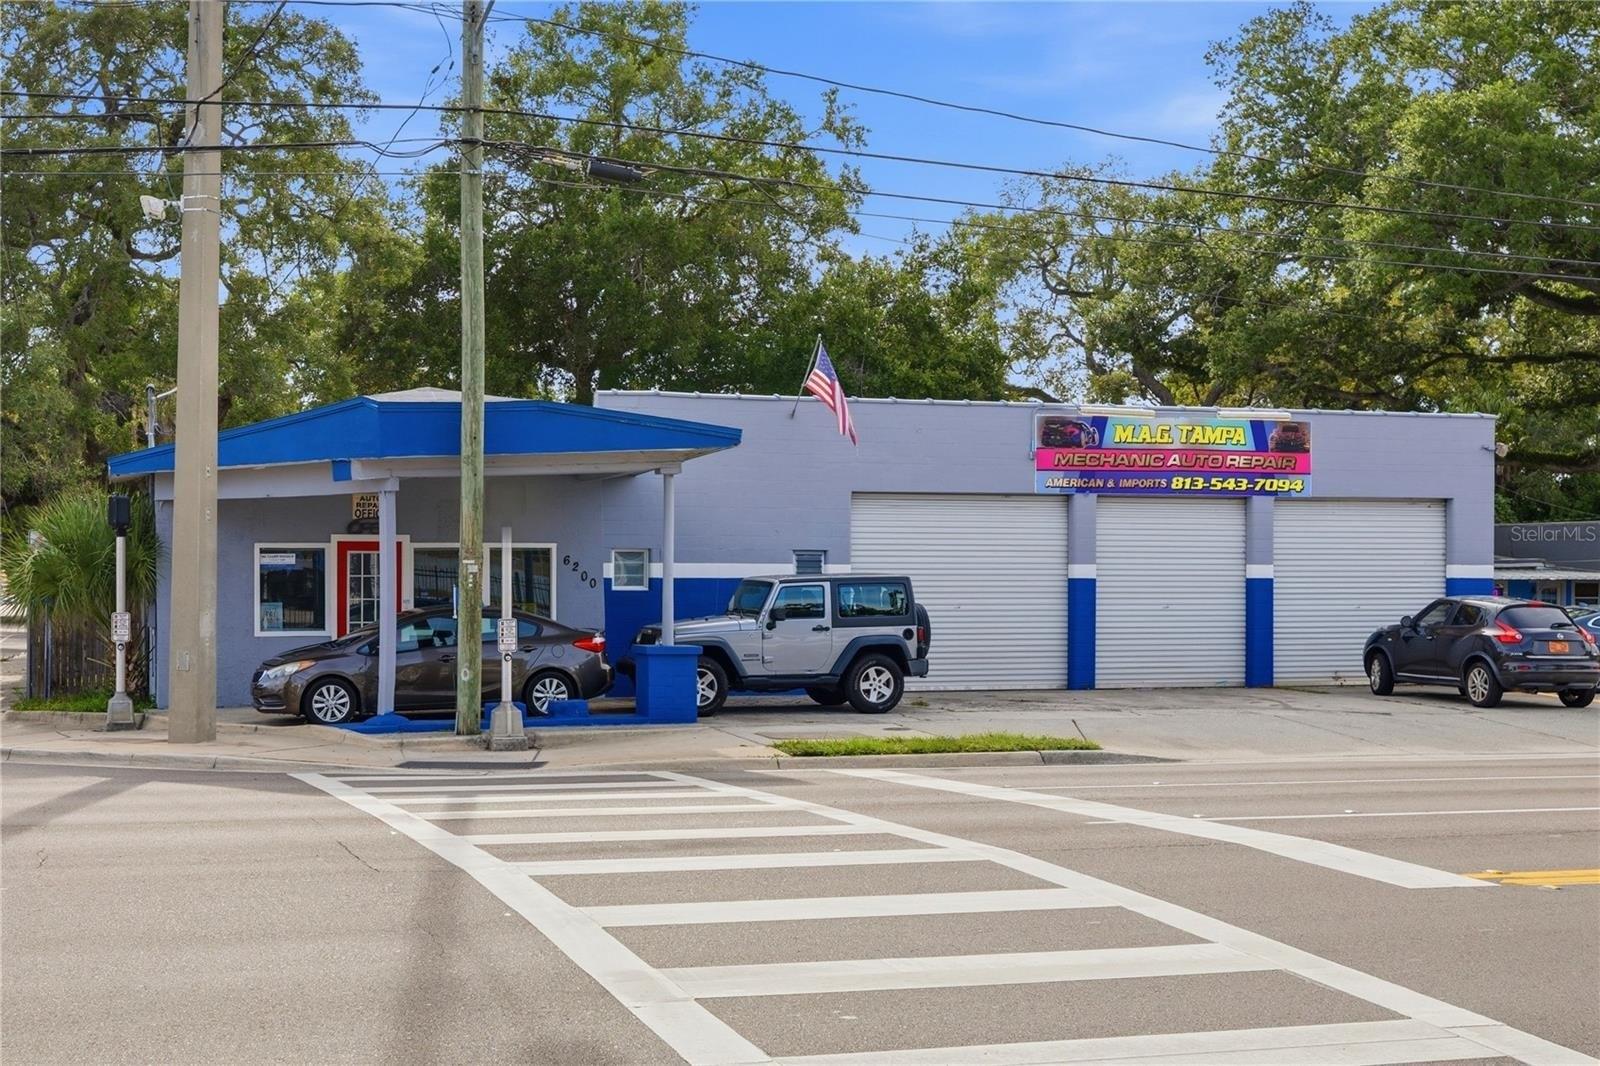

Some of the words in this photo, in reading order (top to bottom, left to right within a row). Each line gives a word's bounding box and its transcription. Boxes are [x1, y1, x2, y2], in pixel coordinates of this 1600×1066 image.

[1113, 424, 1174, 444] M.A.G.
[1175, 425, 1247, 446] TAMPA
[1054, 453, 1165, 468] MECHANIC
[1166, 453, 1223, 468] AUTO
[1225, 454, 1297, 470] REPAIR
[1045, 478, 1104, 489] AMERICAN
[1106, 478, 1116, 489] &
[1119, 478, 1168, 490] IMPORTS
[1170, 476, 1305, 492] 813-543-7094
[354, 508, 379, 519] OFFIC
[563, 555, 597, 589] 6200
